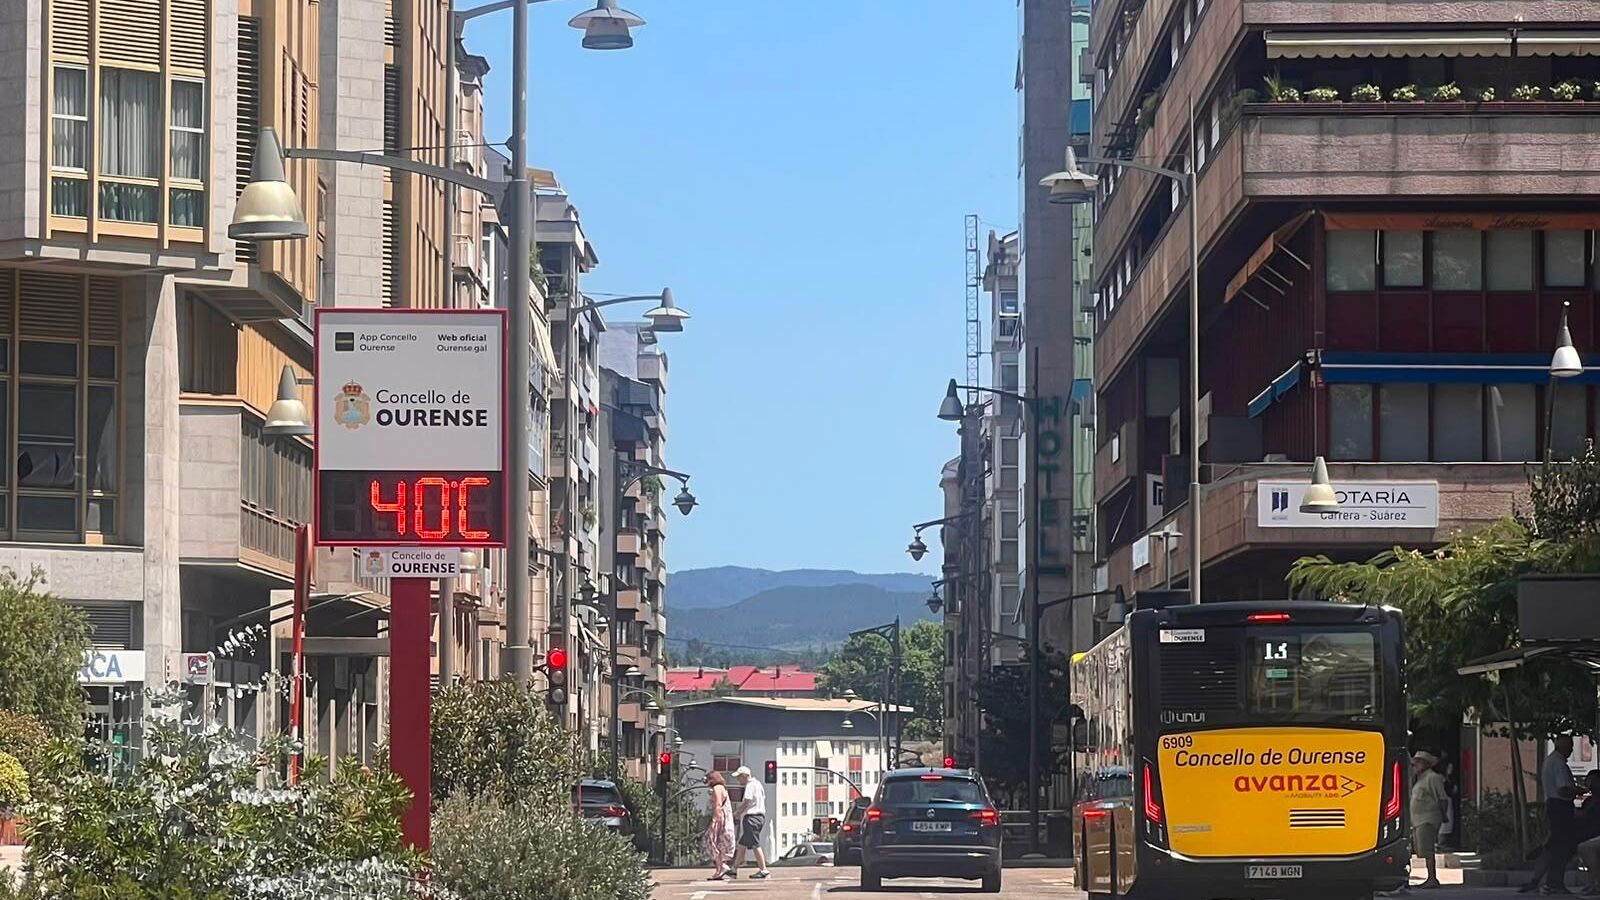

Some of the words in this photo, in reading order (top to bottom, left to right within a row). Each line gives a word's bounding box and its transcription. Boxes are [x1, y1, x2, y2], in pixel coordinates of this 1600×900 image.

[359, 333, 377, 342] App
[380, 333, 417, 341] Concello
[438, 334, 458, 342] Web
[459, 334, 487, 342] oficial
[436, 344, 487, 353] Ourense.gal
[376, 389, 446, 404] Concello
[451, 389, 471, 404] de
[376, 408, 487, 427] OURENSE
[1038, 396, 1063, 561] HOTEL
[1334, 488, 1411, 504] OTARÍA
[1320, 511, 1360, 521] Carrera
[1369, 510, 1407, 521] Suárez
[391, 551, 432, 560] Concello
[434, 551, 445, 560] de
[391, 562, 456, 574] OURENSE
[1162, 735, 1193, 749] 6909
[1175, 748, 1255, 767] Concello
[1260, 748, 1283, 765] de
[1288, 747, 1366, 765] Ourense
[1233, 774, 1338, 792] avanza
[1251, 867, 1278, 877] 7148
[1280, 867, 1301, 877] MGN
